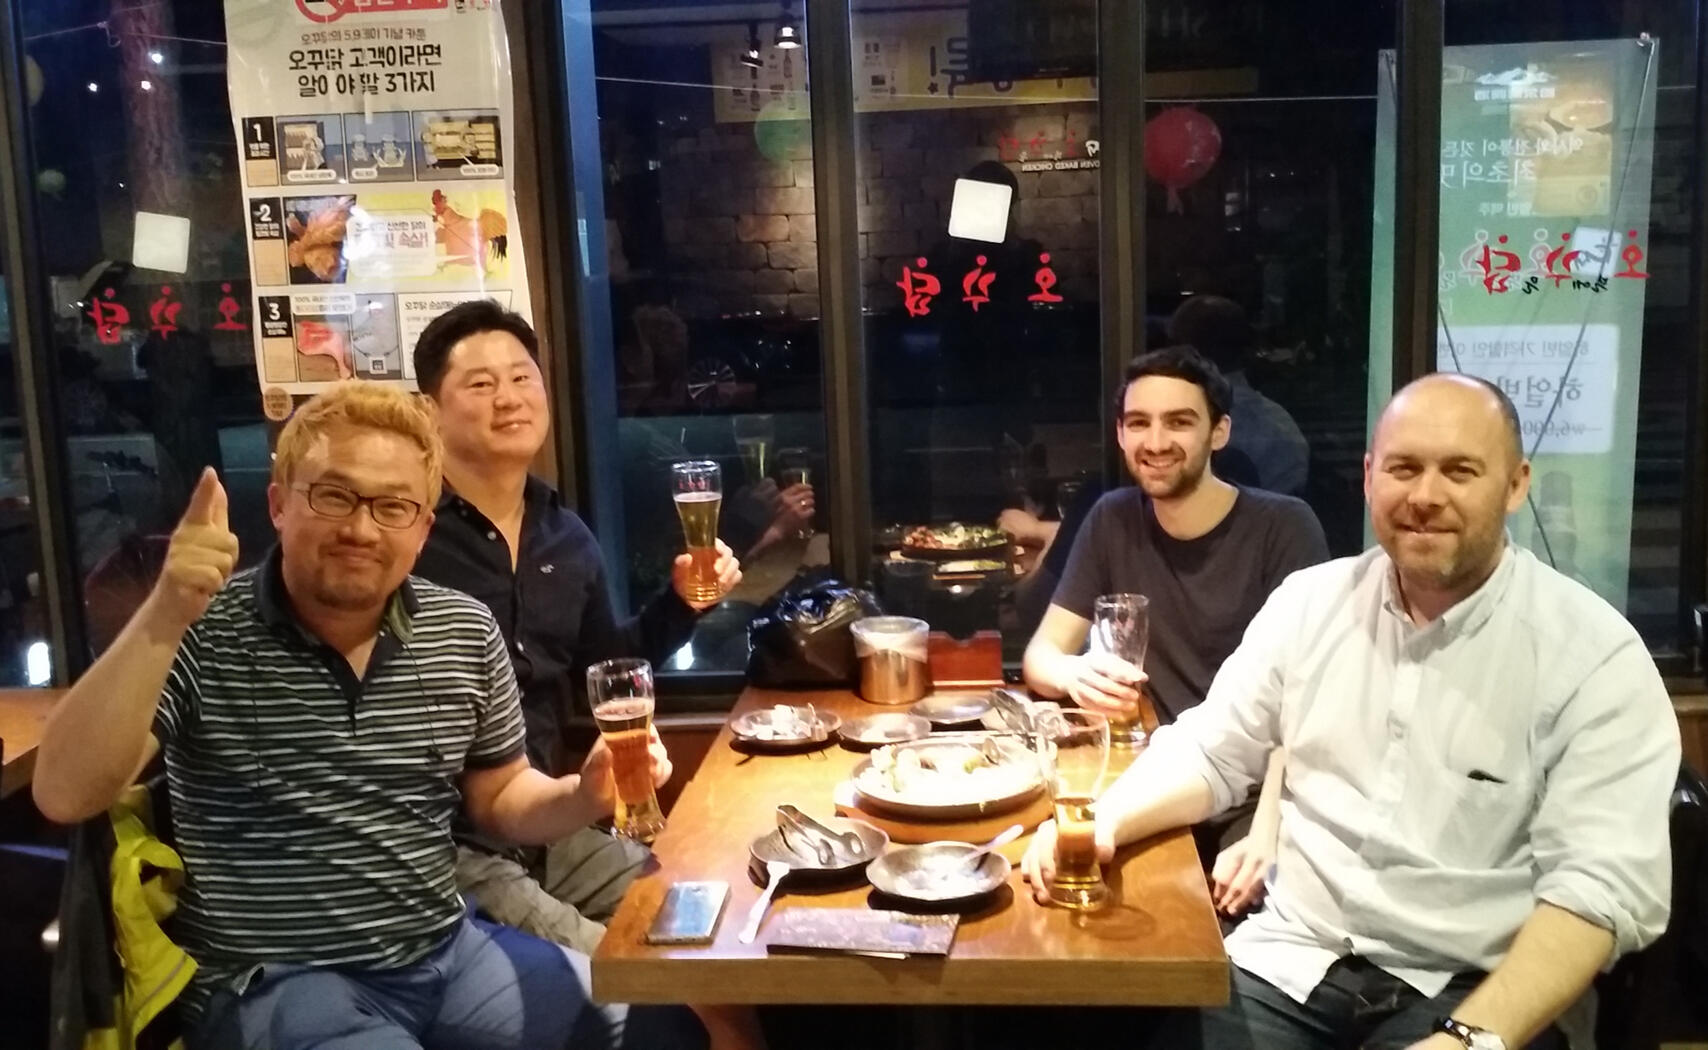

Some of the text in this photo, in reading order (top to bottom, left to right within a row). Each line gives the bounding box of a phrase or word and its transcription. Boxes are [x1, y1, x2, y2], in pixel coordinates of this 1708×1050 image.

[288, 44, 442, 71] 오꾸닭 고객이라면
[385, 70, 435, 93] 3가지
[252, 122, 263, 142] 1
[259, 203, 272, 222] 2
[268, 302, 280, 321] 3
